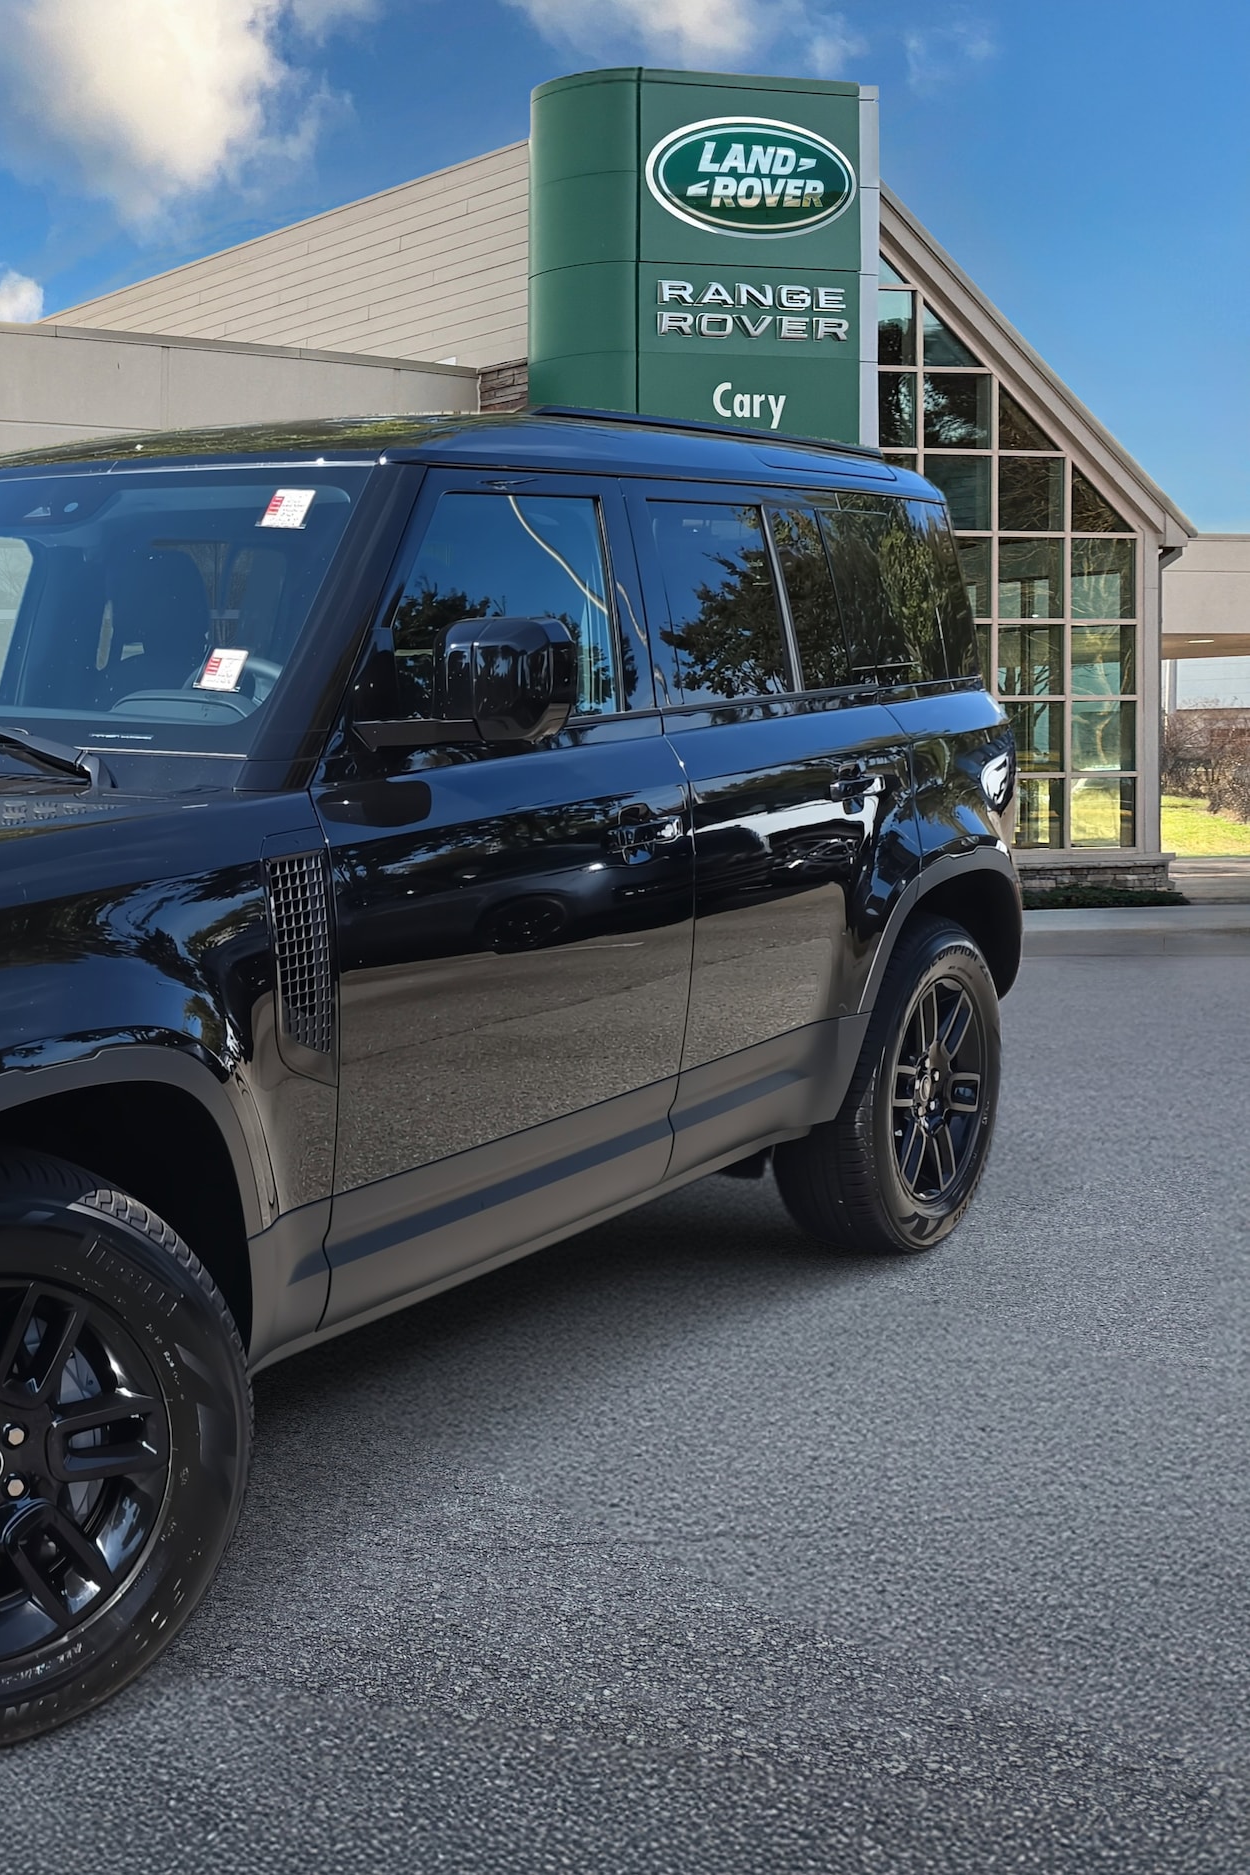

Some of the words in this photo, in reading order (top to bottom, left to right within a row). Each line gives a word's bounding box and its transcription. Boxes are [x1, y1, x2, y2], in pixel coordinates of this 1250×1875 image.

[697, 141, 798, 176] LAND
[710, 176, 825, 208] ROVER
[657, 280, 847, 312] RANGE
[657, 311, 850, 342] ROVER
[712, 382, 787, 429] Cary
